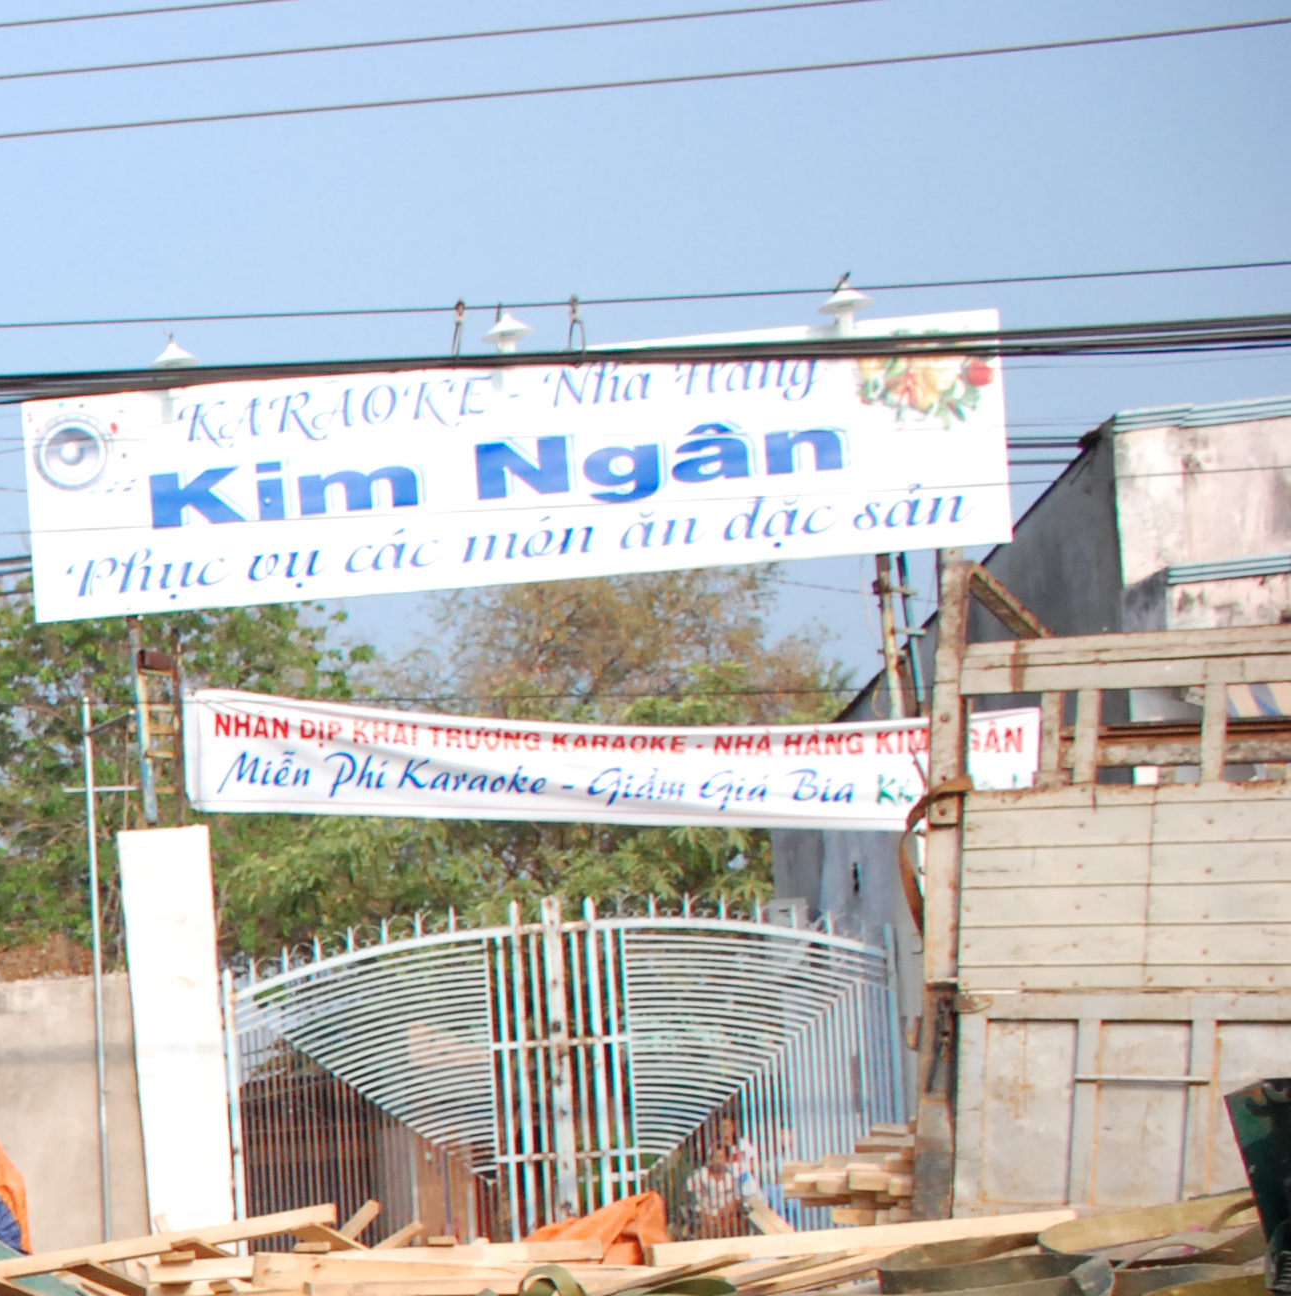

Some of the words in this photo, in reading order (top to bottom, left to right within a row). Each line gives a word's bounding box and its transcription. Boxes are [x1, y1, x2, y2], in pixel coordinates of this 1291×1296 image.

[178, 375, 492, 448] KARAOKE
[149, 460, 419, 529] Kim
[474, 423, 846, 503] Ngân
[66, 548, 227, 600] Phục
[247, 549, 325, 589] vụ
[344, 528, 441, 573] các
[462, 515, 596, 563] món
[619, 510, 706, 550] ăn
[723, 496, 837, 548] đặc
[853, 483, 973, 531] sản
[300, 719, 343, 748] DỊP
[353, 719, 418, 746] KHAI
[428, 726, 541, 751] TRƯƠNG
[552, 734, 687, 754] KARAOKE
[713, 728, 773, 756] NHÀ
[783, 727, 865, 756] HÀNG
[875, 728, 930, 755] KIM
[216, 750, 312, 794] Miễn
[324, 751, 388, 797] Phí
[397, 758, 548, 795] Karaoke
[586, 767, 687, 807] Giảm
[698, 769, 769, 811] Giá
[784, 768, 855, 804] Bia
